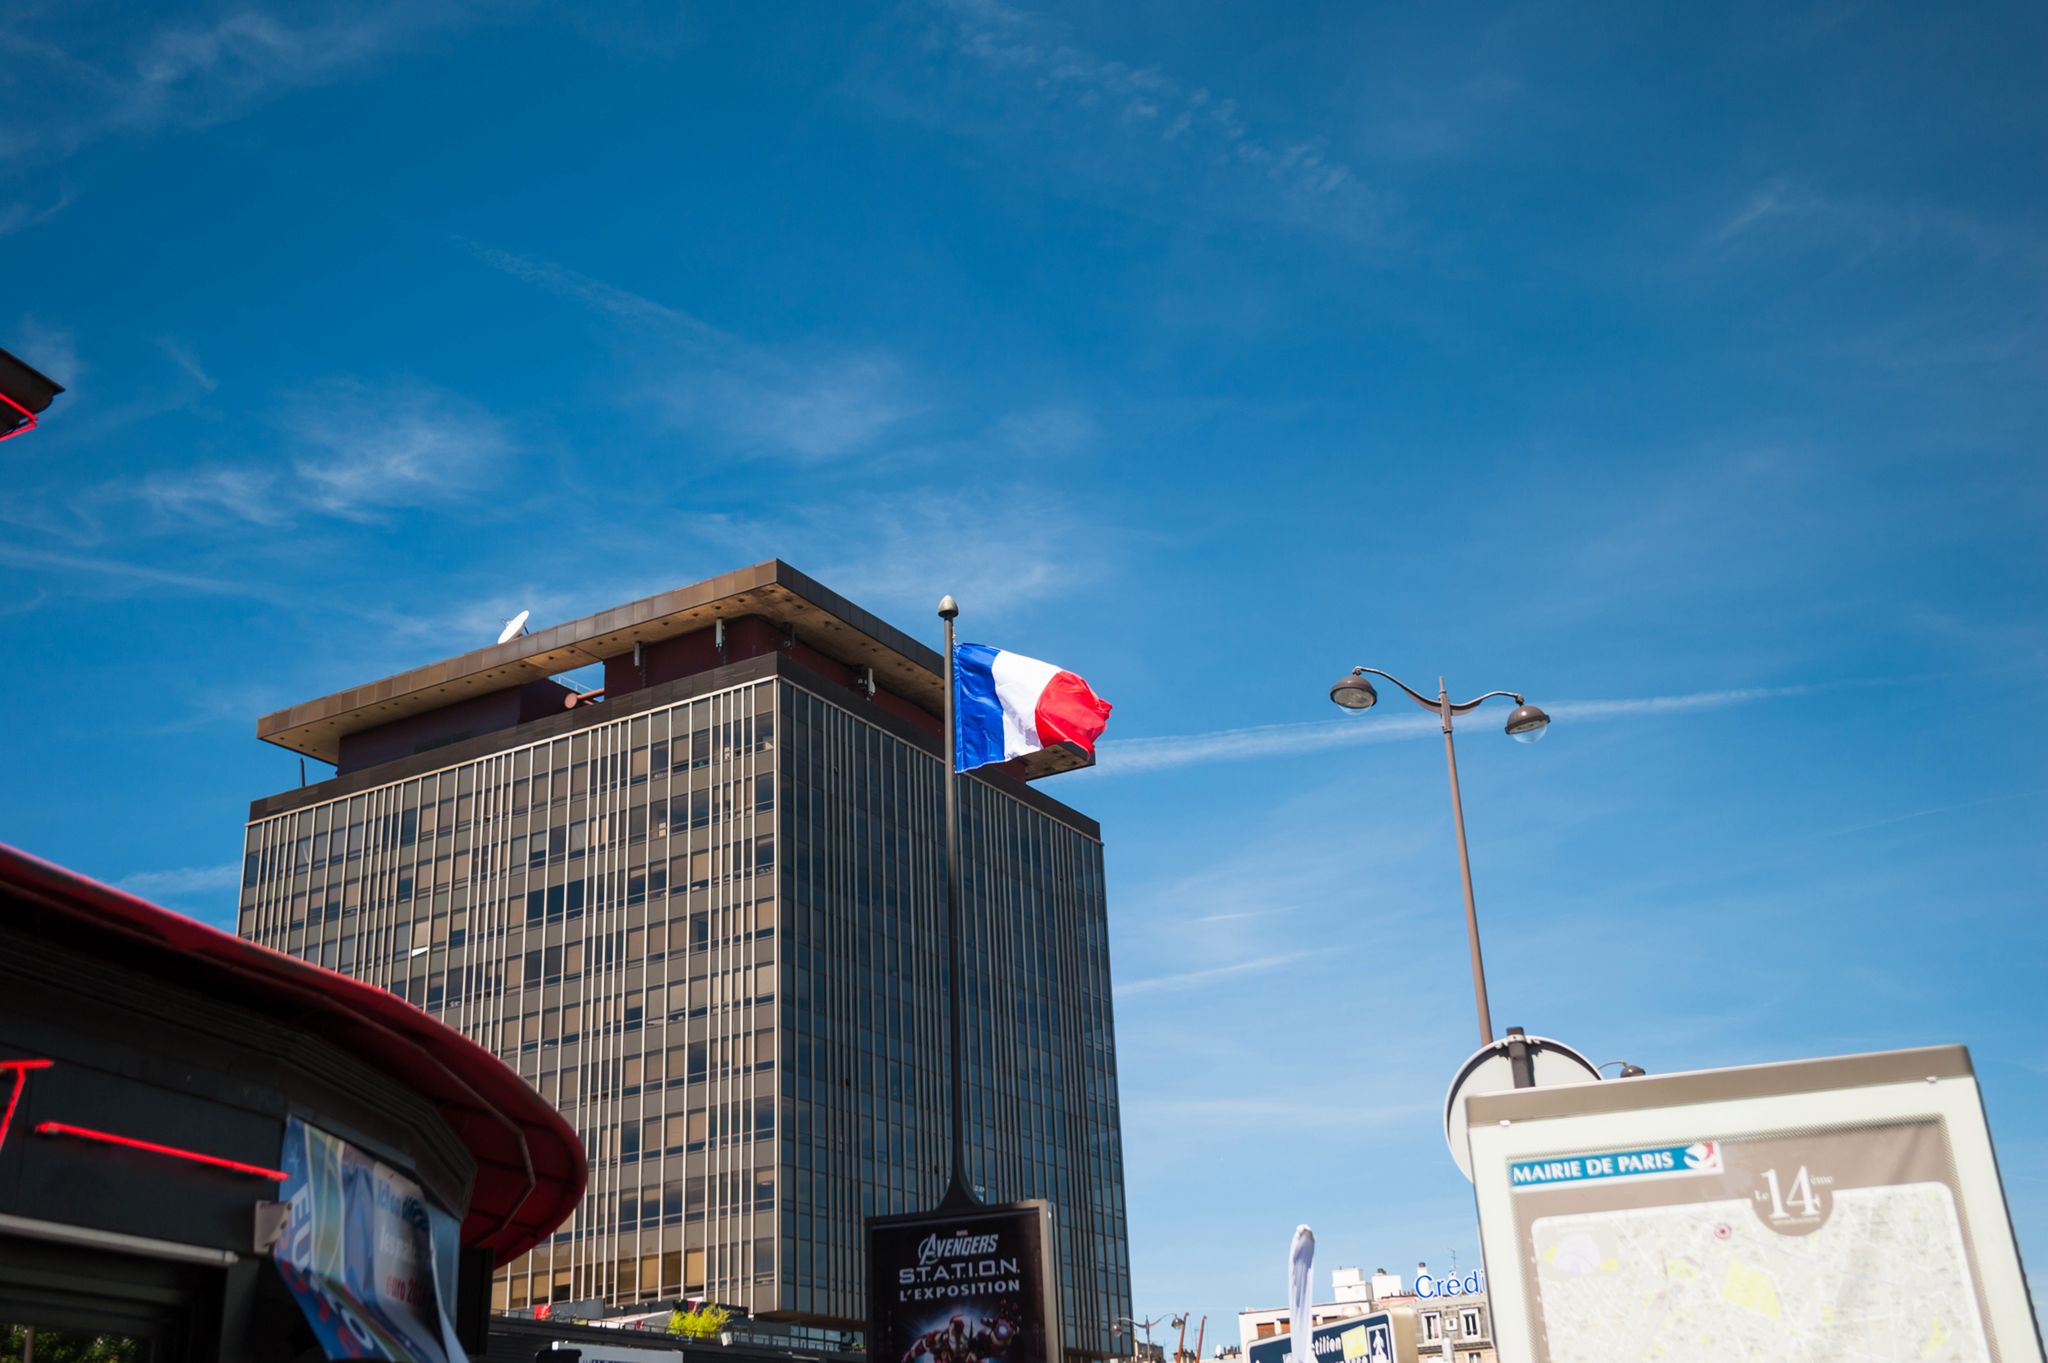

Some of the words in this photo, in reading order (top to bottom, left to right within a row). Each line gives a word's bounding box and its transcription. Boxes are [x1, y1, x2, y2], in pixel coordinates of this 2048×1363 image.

[1513, 1159, 1581, 1184] MAIRIE
[1586, 1157, 1614, 1177] DE
[1618, 1151, 1675, 1173] PARIS
[900, 1279, 1021, 1303] L'EXPOSITION
